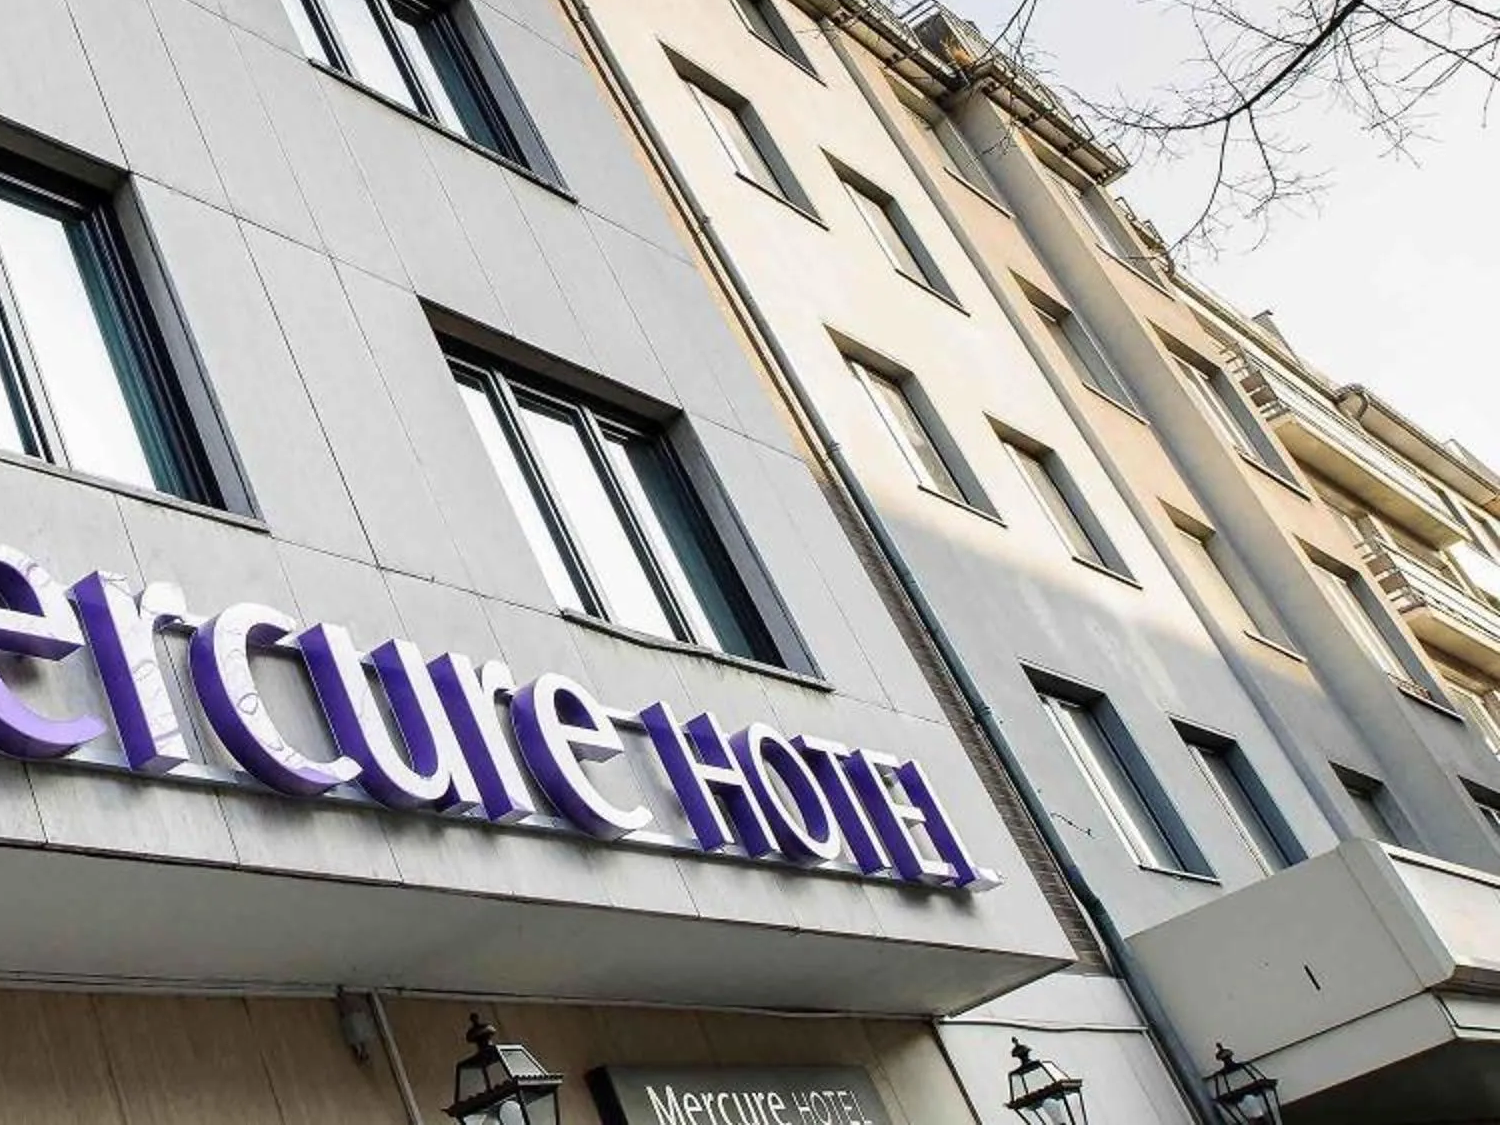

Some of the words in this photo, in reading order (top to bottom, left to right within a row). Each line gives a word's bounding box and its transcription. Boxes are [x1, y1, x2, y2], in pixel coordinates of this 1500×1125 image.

[640, 701, 1002, 891] HOTEL
[646, 1085, 791, 1125] Mercure
[792, 1090, 872, 1125] HOTEL
